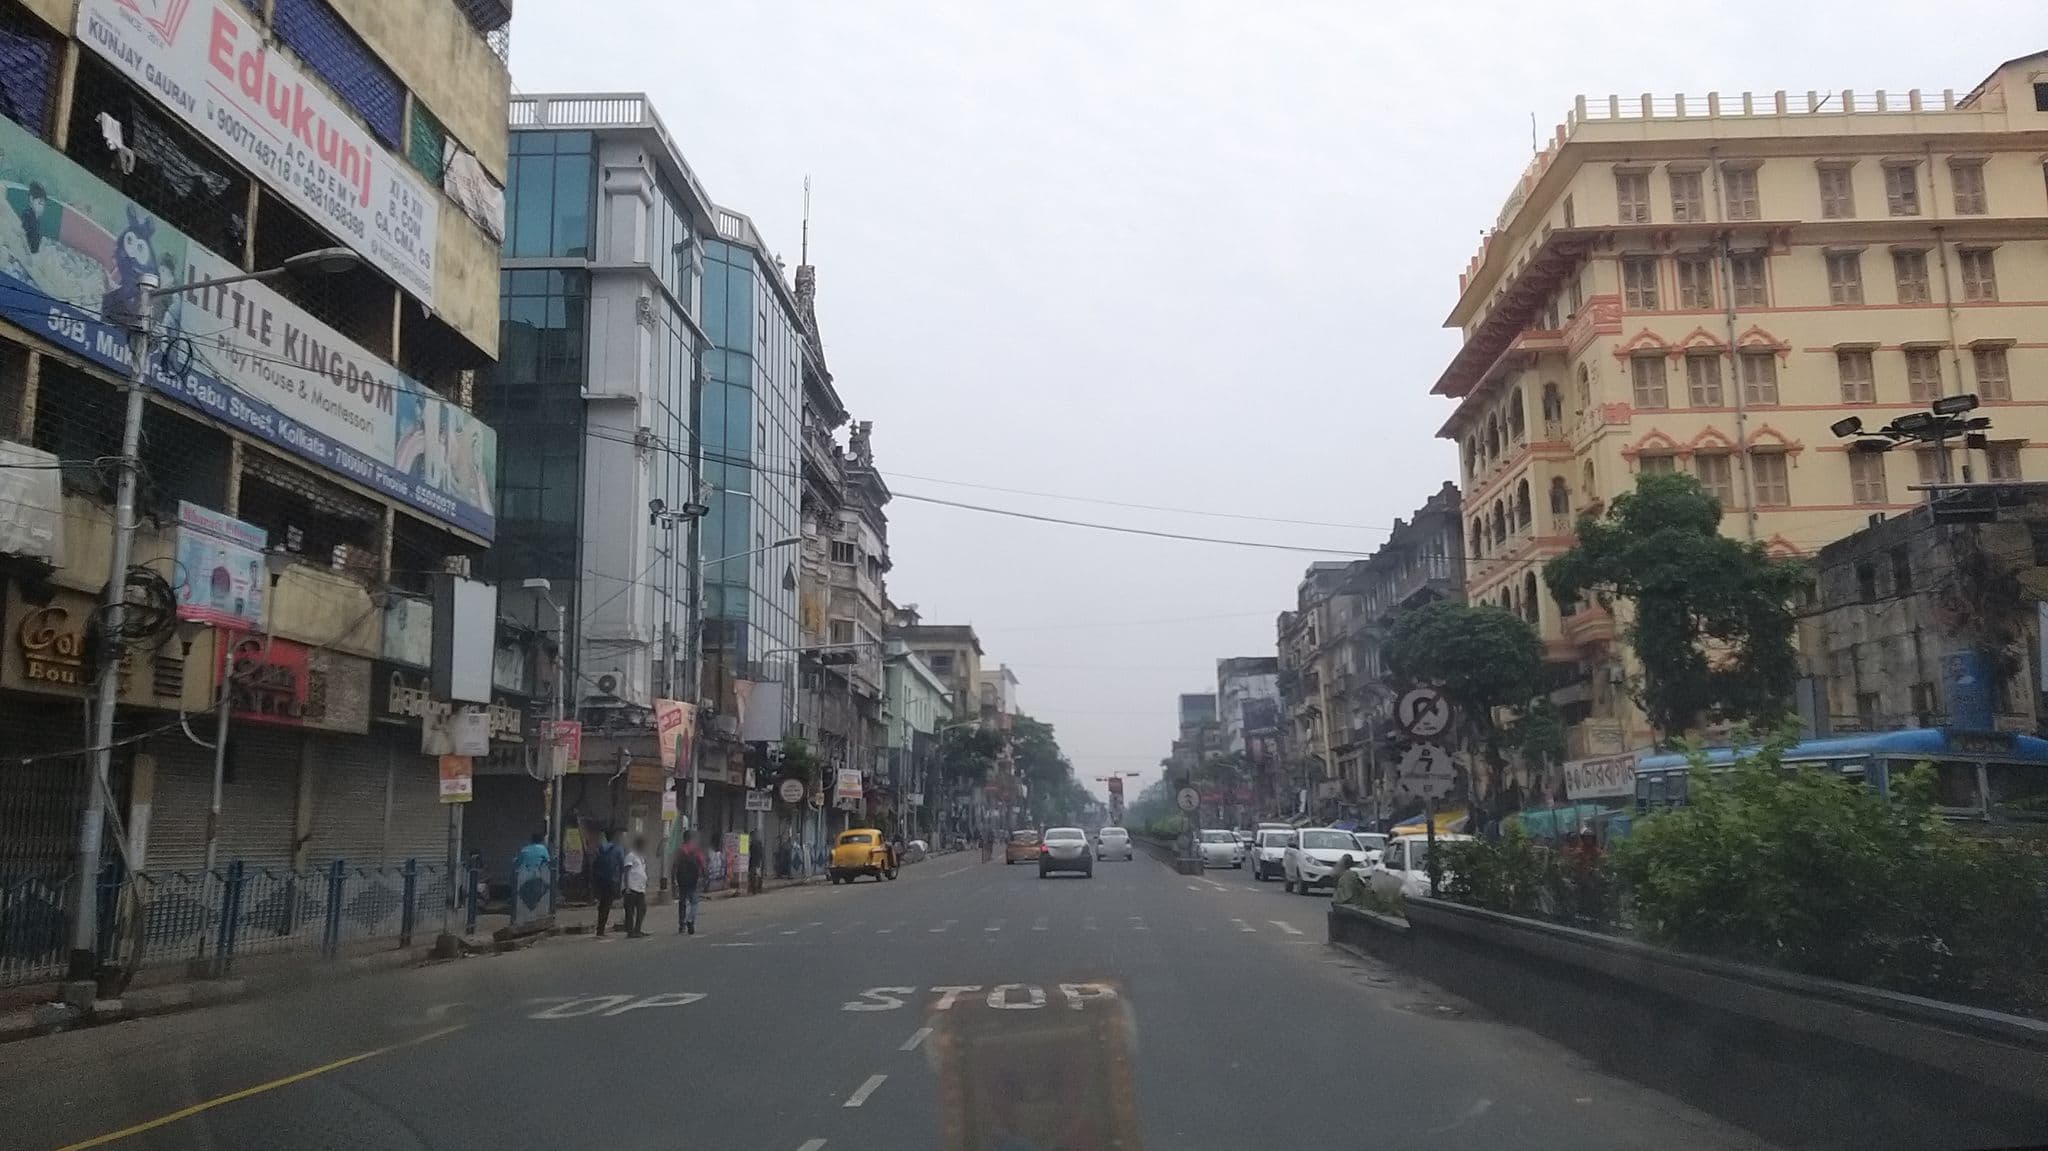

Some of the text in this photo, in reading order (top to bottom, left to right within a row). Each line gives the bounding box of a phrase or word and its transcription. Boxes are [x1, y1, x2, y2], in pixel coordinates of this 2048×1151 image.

[88, 17, 142, 71] KUNJAY
[146, 62, 196, 113] GAURAV
[209, 7, 372, 209] Edukunj
[286, 142, 357, 208] ACADEMY
[401, 210, 422, 241] COM
[419, 248, 431, 270] CS
[186, 264, 273, 347] LITTLE
[284, 322, 394, 416] KINGDOM
[186, 374, 227, 411] Babu
[278, 418, 327, 458] Kolkata
[251, 353, 294, 393] House
[298, 379, 308, 400] &
[311, 387, 375, 434] Montessori
[28, 661, 76, 684] Bou
[840, 982, 1118, 1010] STOP
